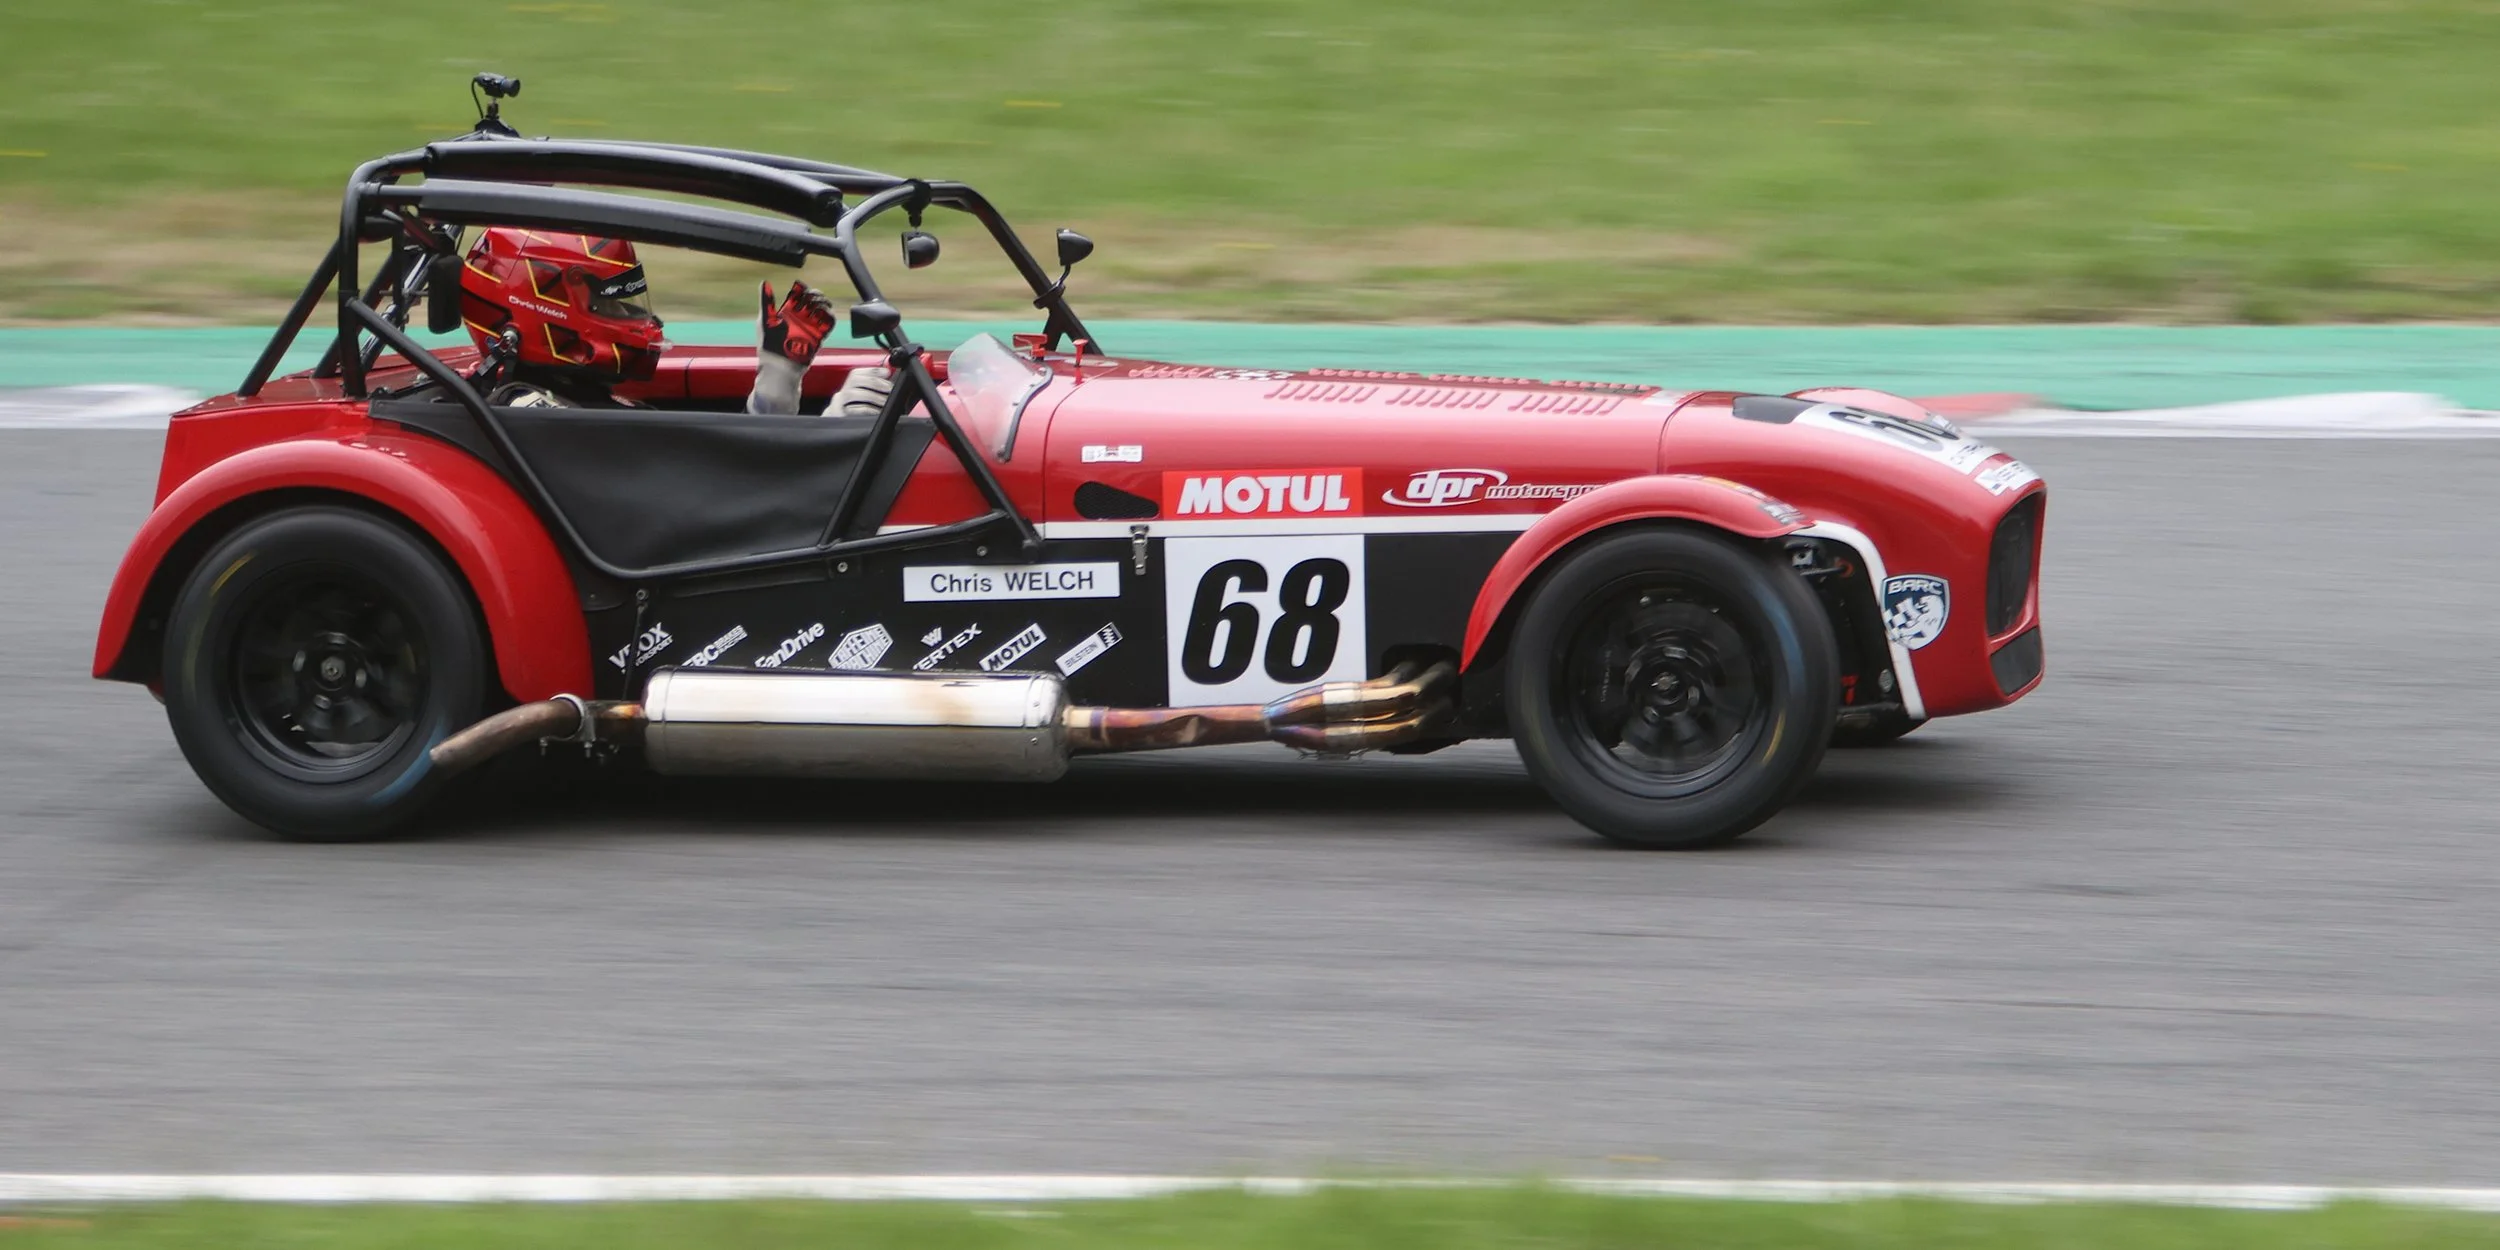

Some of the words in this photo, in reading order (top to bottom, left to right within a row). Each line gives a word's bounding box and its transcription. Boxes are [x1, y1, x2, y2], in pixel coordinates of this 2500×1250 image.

[508, 295, 534, 311] Chris
[535, 304, 568, 321] Welch
[1176, 475, 1350, 514] MOTUL
[1406, 471, 1486, 505] dpr
[1484, 483, 1607, 502] motorspo
[930, 573, 992, 594] Chris
[1005, 571, 1094, 592] WELCH
[1888, 579, 1943, 595] BARC
[1181, 557, 1350, 685] 68
[621, 635, 673, 674] ORSPORT
[912, 622, 982, 670] ERTEX
[988, 629, 1041, 670] MOTUL
[1065, 642, 1099, 669] BILSTEIN
